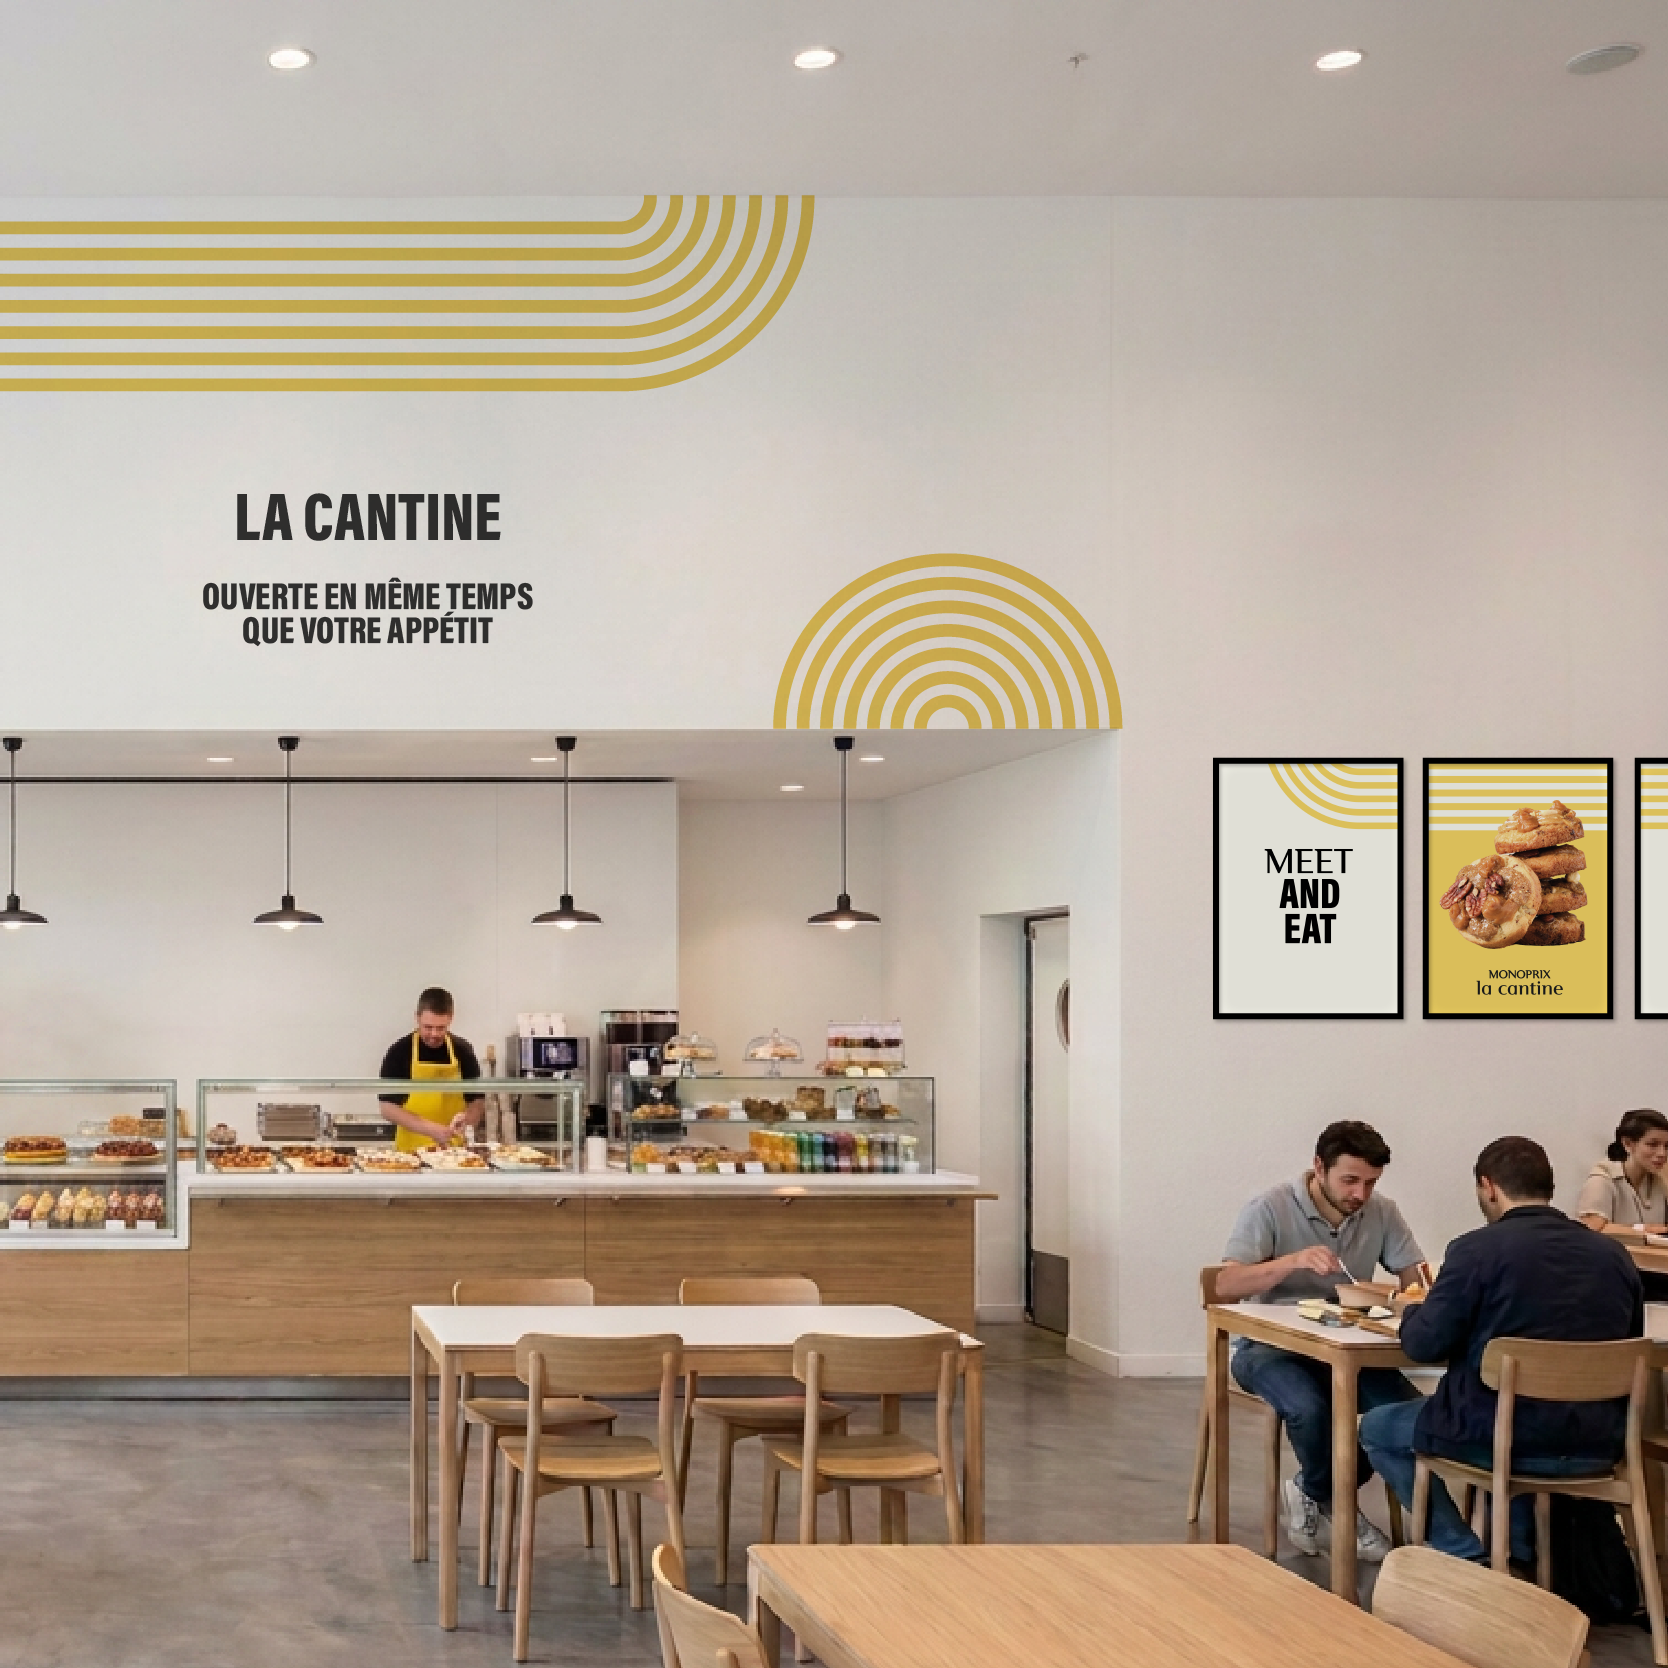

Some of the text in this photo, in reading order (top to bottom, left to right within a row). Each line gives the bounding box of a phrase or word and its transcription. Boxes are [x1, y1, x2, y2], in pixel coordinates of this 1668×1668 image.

[236, 492, 501, 542] LA CANTINE
[202, 577, 533, 610] OUVERTE EN MÊME TEMPS
[242, 611, 494, 647] QUE VOTRE APPÉTIT
[1264, 848, 1354, 874] MEET
[1279, 878, 1340, 909] AND
[1284, 913, 1337, 944] EAT
[1476, 980, 1564, 996] la cantine
[1488, 969, 1551, 979] MONOPRIX
